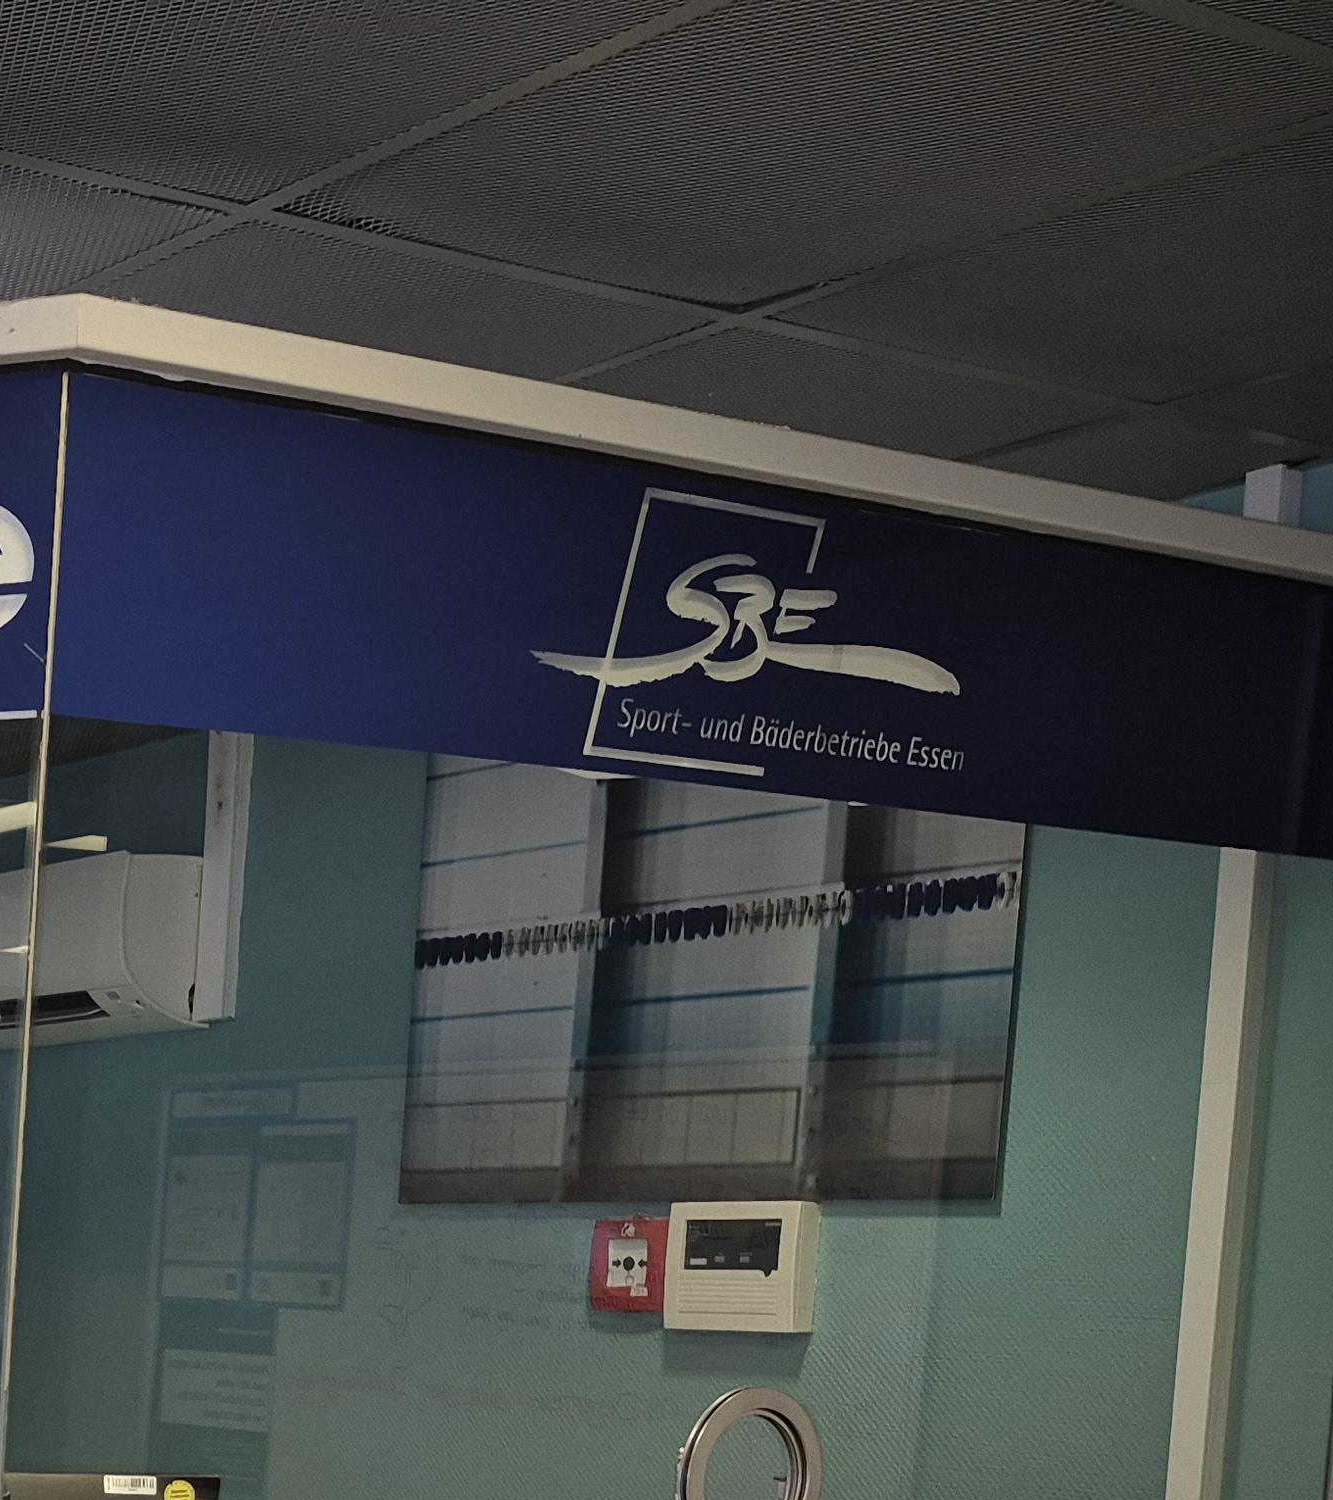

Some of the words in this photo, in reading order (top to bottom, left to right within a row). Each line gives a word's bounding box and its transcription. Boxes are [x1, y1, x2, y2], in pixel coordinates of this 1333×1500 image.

[617, 698, 692, 737] Sport-
[700, 714, 745, 743] und
[750, 715, 901, 764] Bäderbetriebe
[906, 736, 965, 771] Essen
